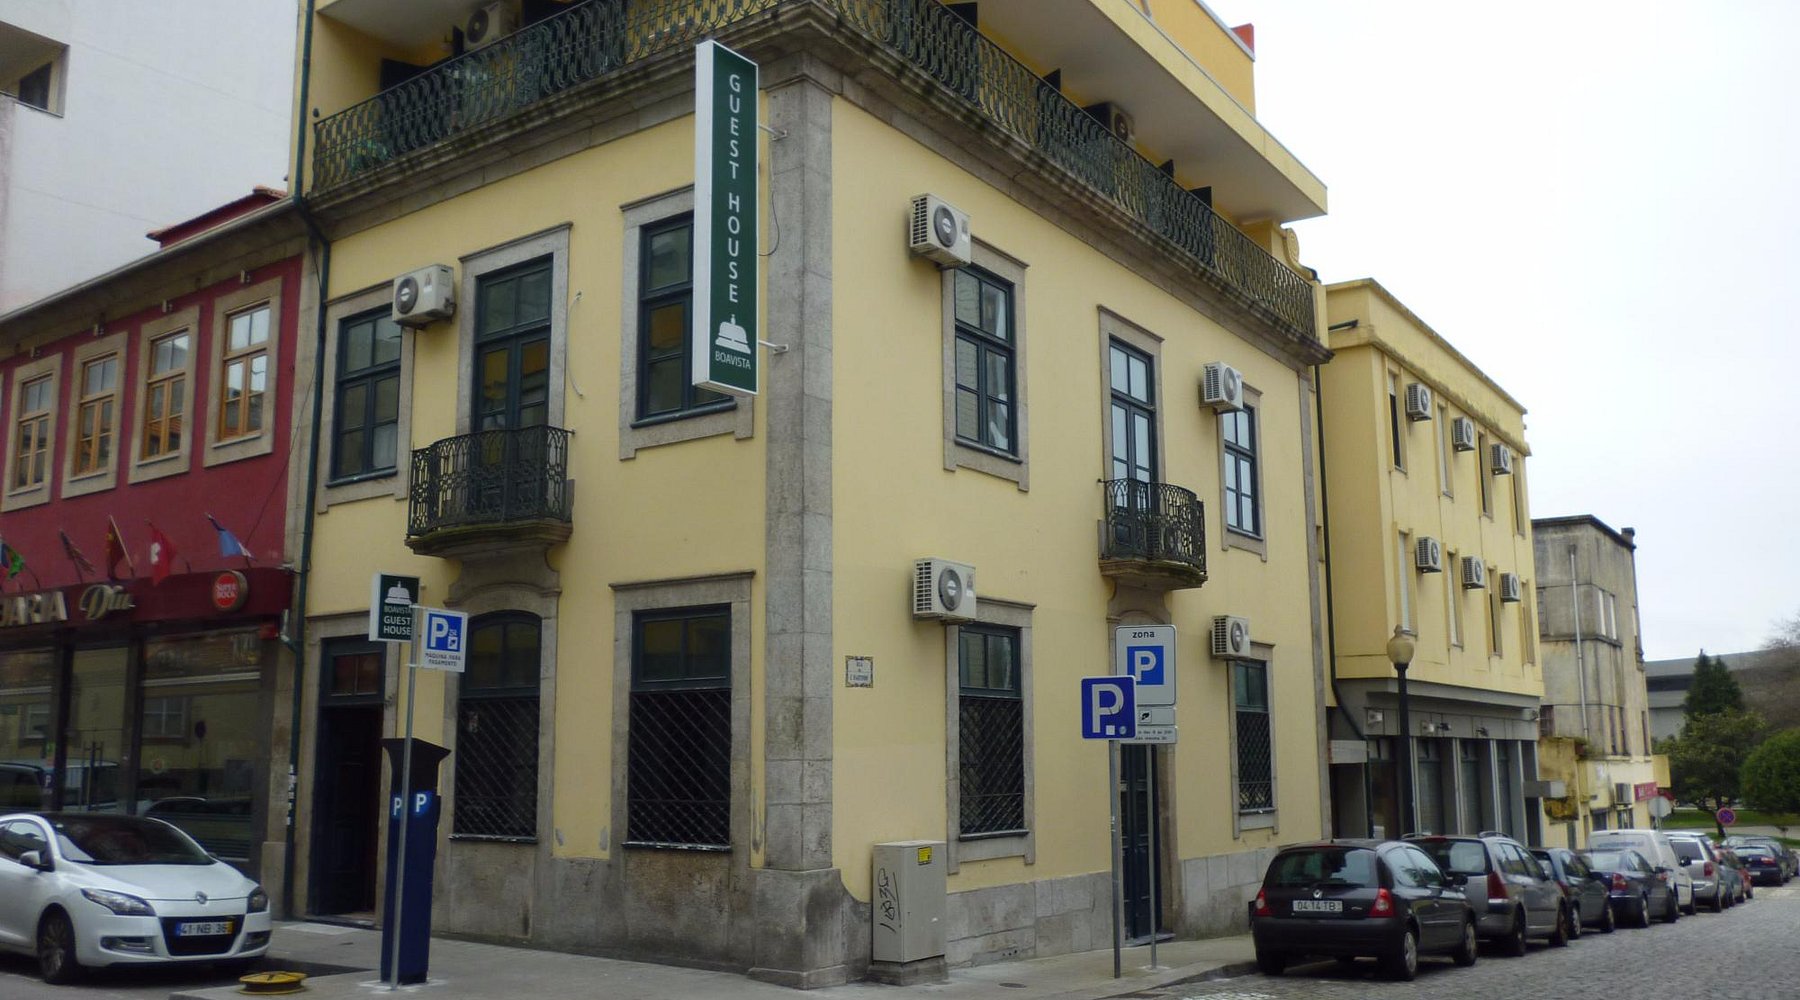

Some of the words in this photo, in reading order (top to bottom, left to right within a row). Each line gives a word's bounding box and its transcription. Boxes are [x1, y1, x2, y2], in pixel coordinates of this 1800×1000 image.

[729, 74, 741, 180] GUEST
[728, 192, 741, 303] HOUSE
[715, 350, 751, 370] BOAVISTA
[383, 615, 412, 626] GUEST
[383, 625, 412, 636] HOUSE
[430, 616, 449, 648] P
[1132, 631, 1155, 639] zona
[1134, 650, 1157, 682] P
[1092, 683, 1124, 734] P
[393, 797, 402, 816] P
[416, 793, 427, 813] P
